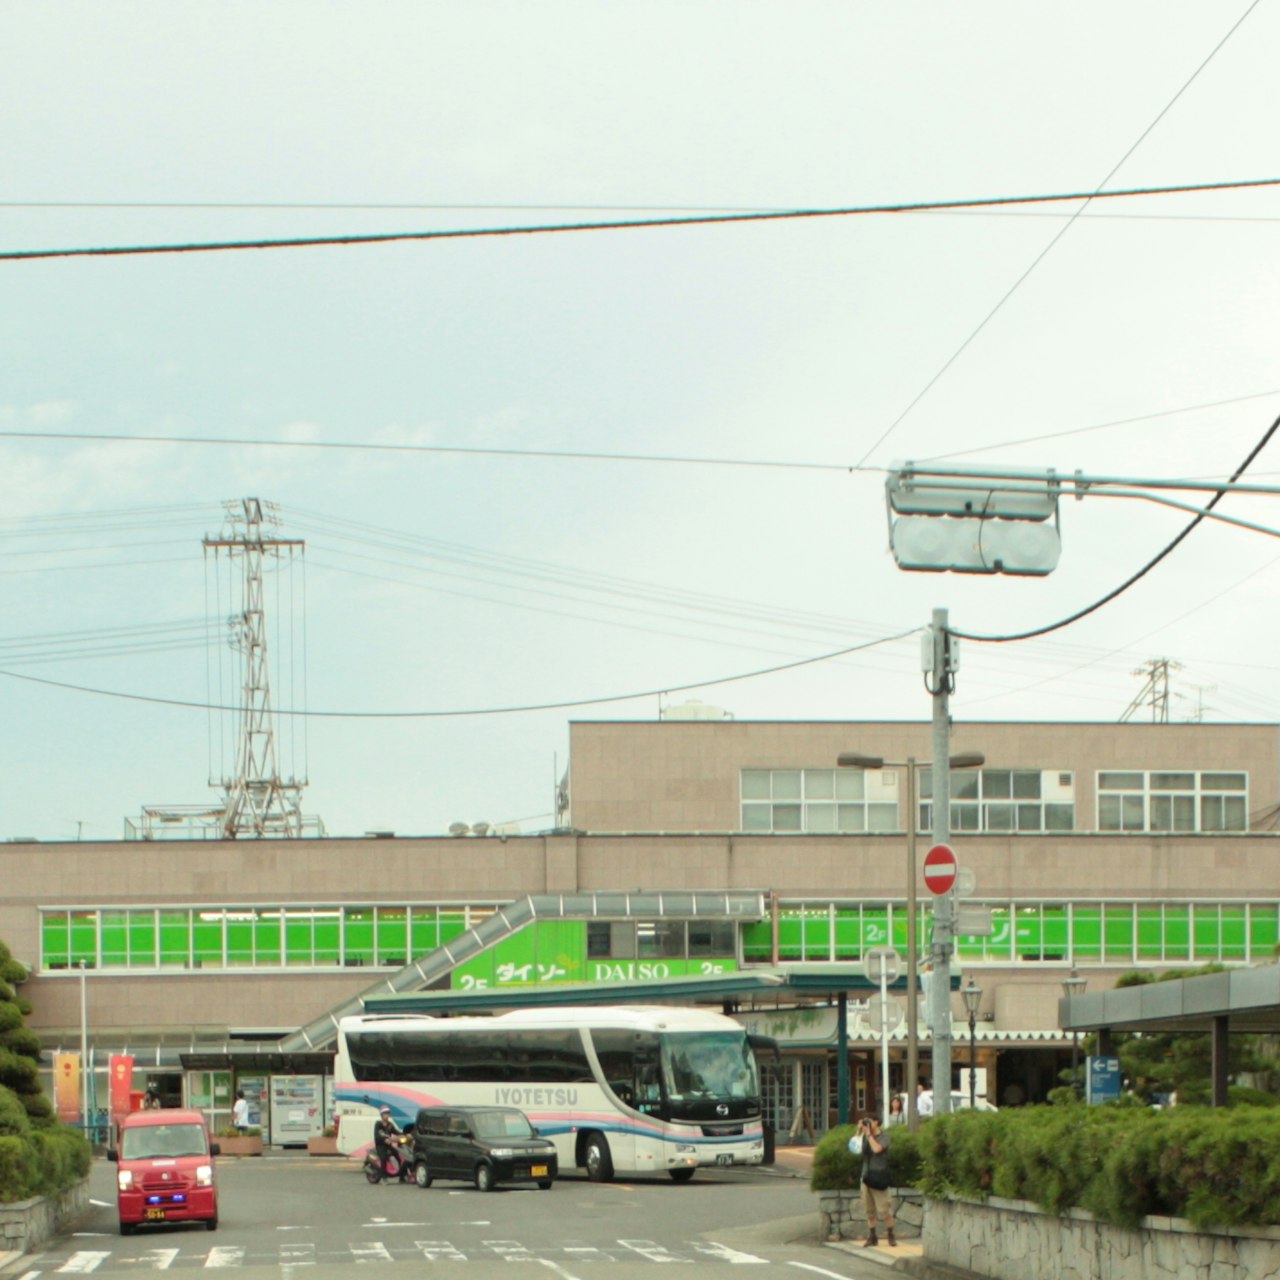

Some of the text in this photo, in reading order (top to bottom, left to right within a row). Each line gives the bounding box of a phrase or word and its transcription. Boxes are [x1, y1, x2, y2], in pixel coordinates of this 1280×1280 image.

[866, 924, 887, 943] 2F
[496, 961, 566, 982] ダイソー
[595, 963, 670, 981] DAISO
[495, 1087, 579, 1106] IYOTETSU
